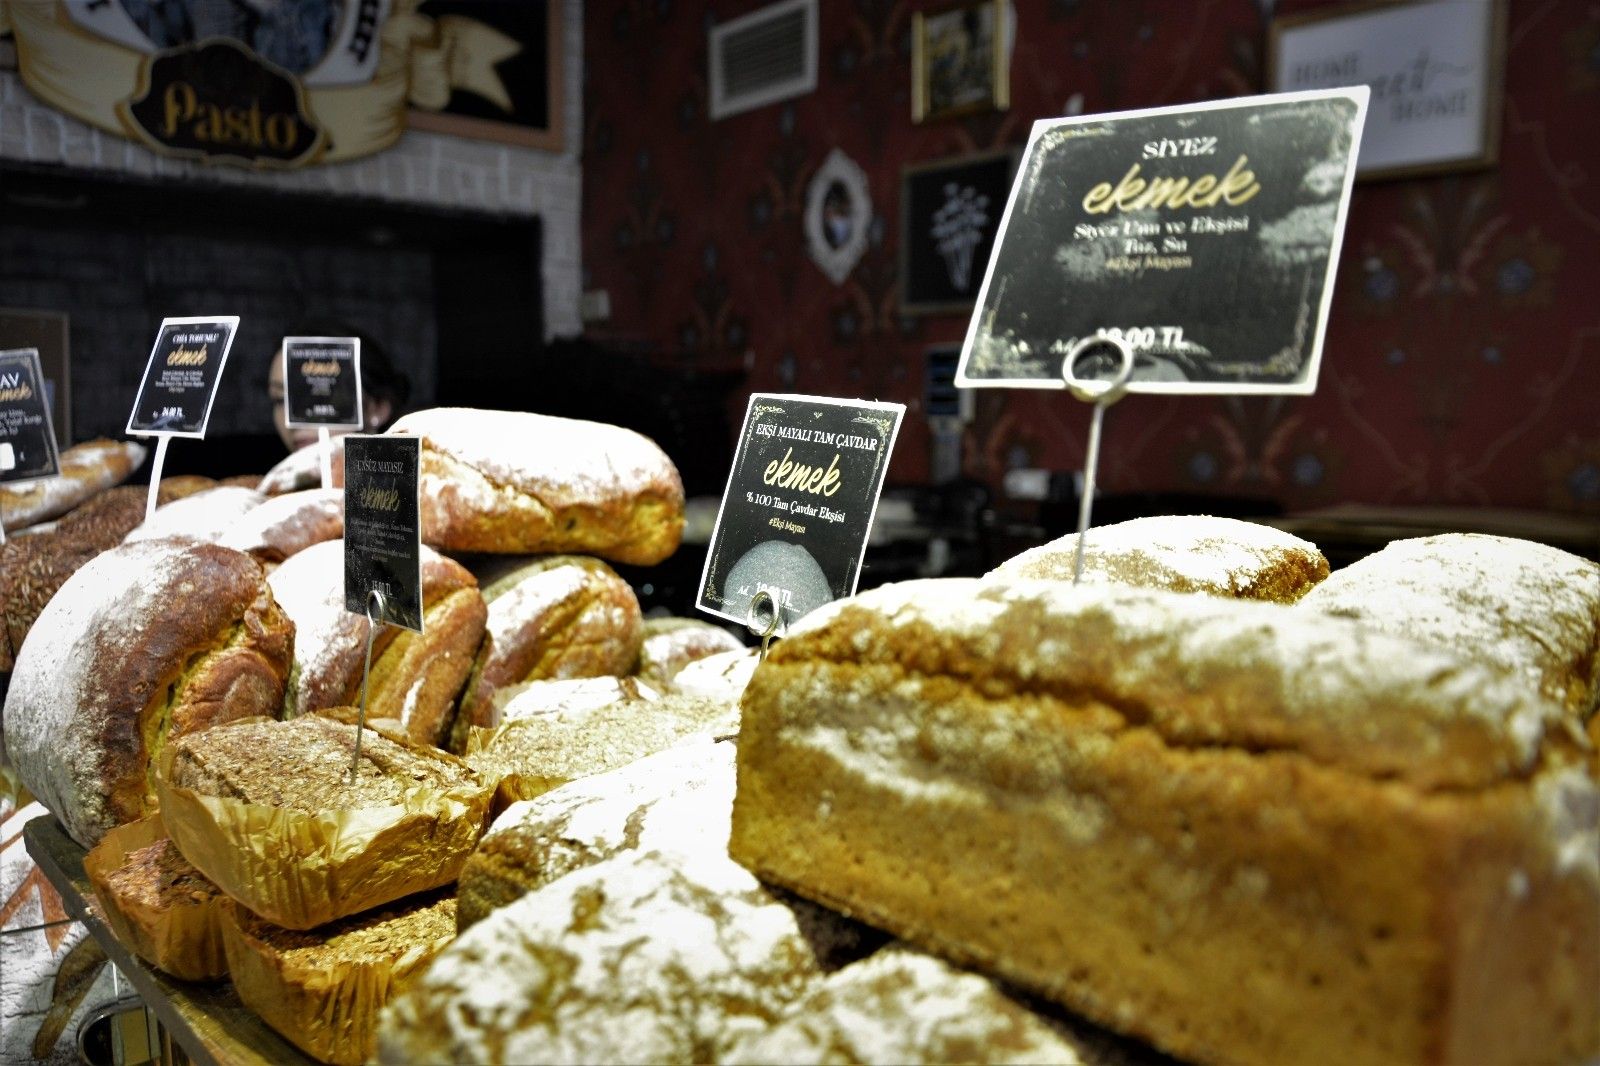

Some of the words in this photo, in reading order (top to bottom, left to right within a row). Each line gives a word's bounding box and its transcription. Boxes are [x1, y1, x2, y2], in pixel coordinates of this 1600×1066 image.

[162, 81, 298, 149] Pasto
[1141, 135, 1219, 161] SİYEZ
[1082, 154, 1262, 215] ekmek
[1165, 221, 1187, 235] ve
[1159, 326, 1192, 350] TL
[756, 423, 778, 438] EKŞİ
[777, 426, 812, 442] MAYALI
[813, 430, 836, 445] TAM
[835, 433, 878, 451] ÇAVDAR
[763, 446, 842, 497] ekmek
[360, 476, 400, 512] ekmek
[772, 496, 789, 511] Tam
[790, 500, 819, 515] Çavdar
[818, 506, 846, 523] Ekşisi
